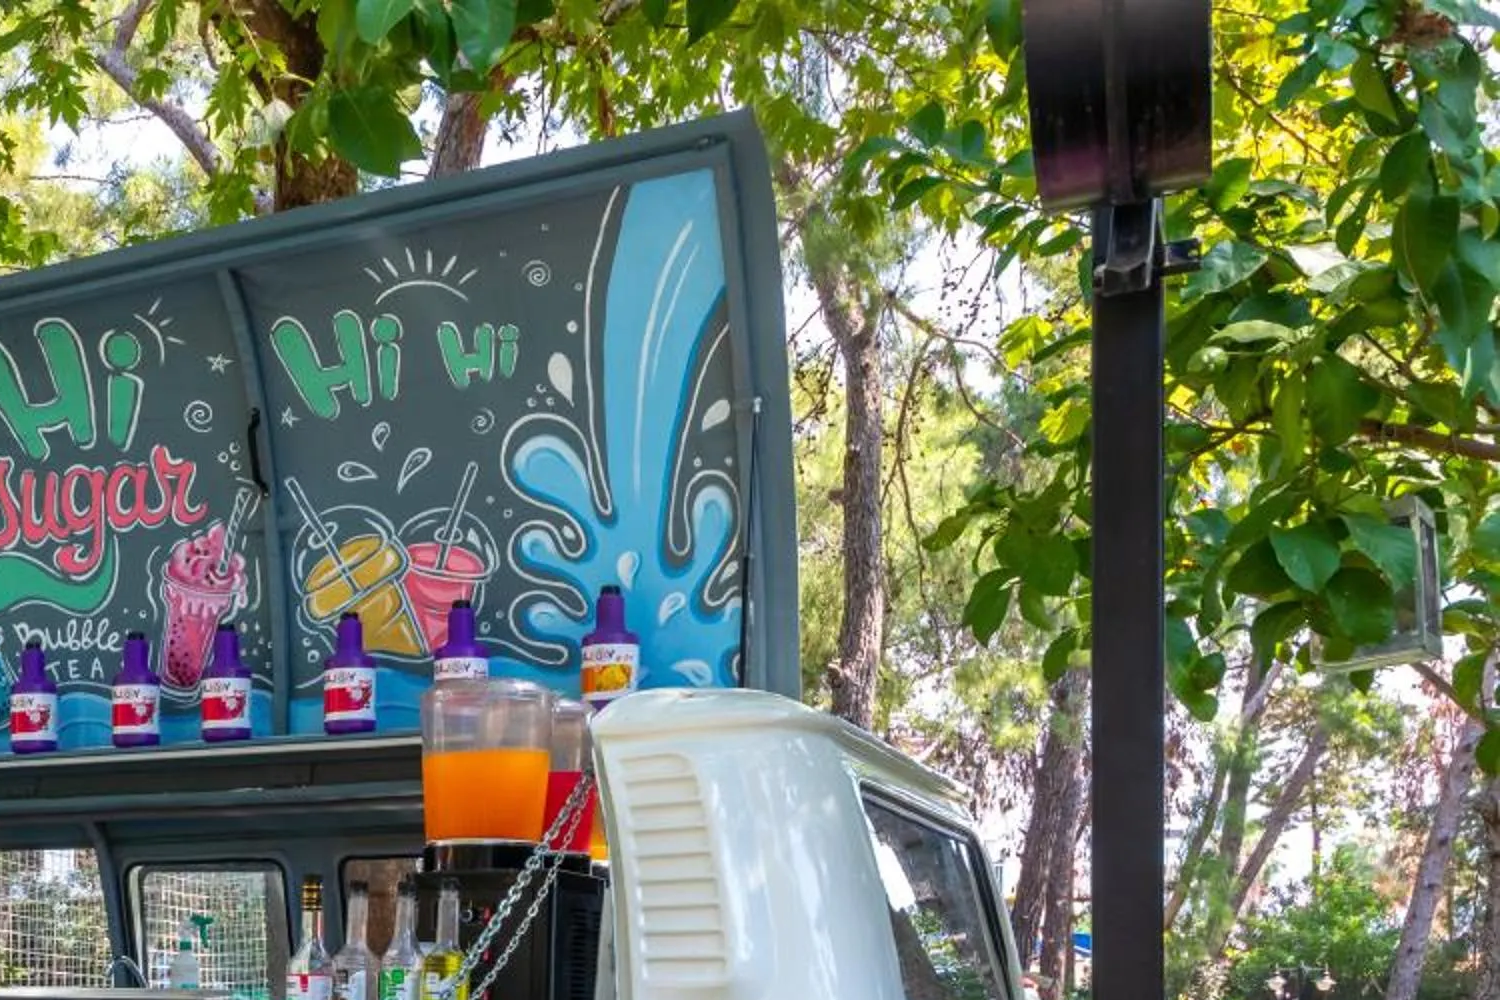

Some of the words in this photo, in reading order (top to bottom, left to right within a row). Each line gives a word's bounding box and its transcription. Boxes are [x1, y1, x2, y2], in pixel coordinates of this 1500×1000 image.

[270, 310, 401, 420] Hi
[437, 322, 519, 388] Hi
[44, 657, 105, 680] TEA
